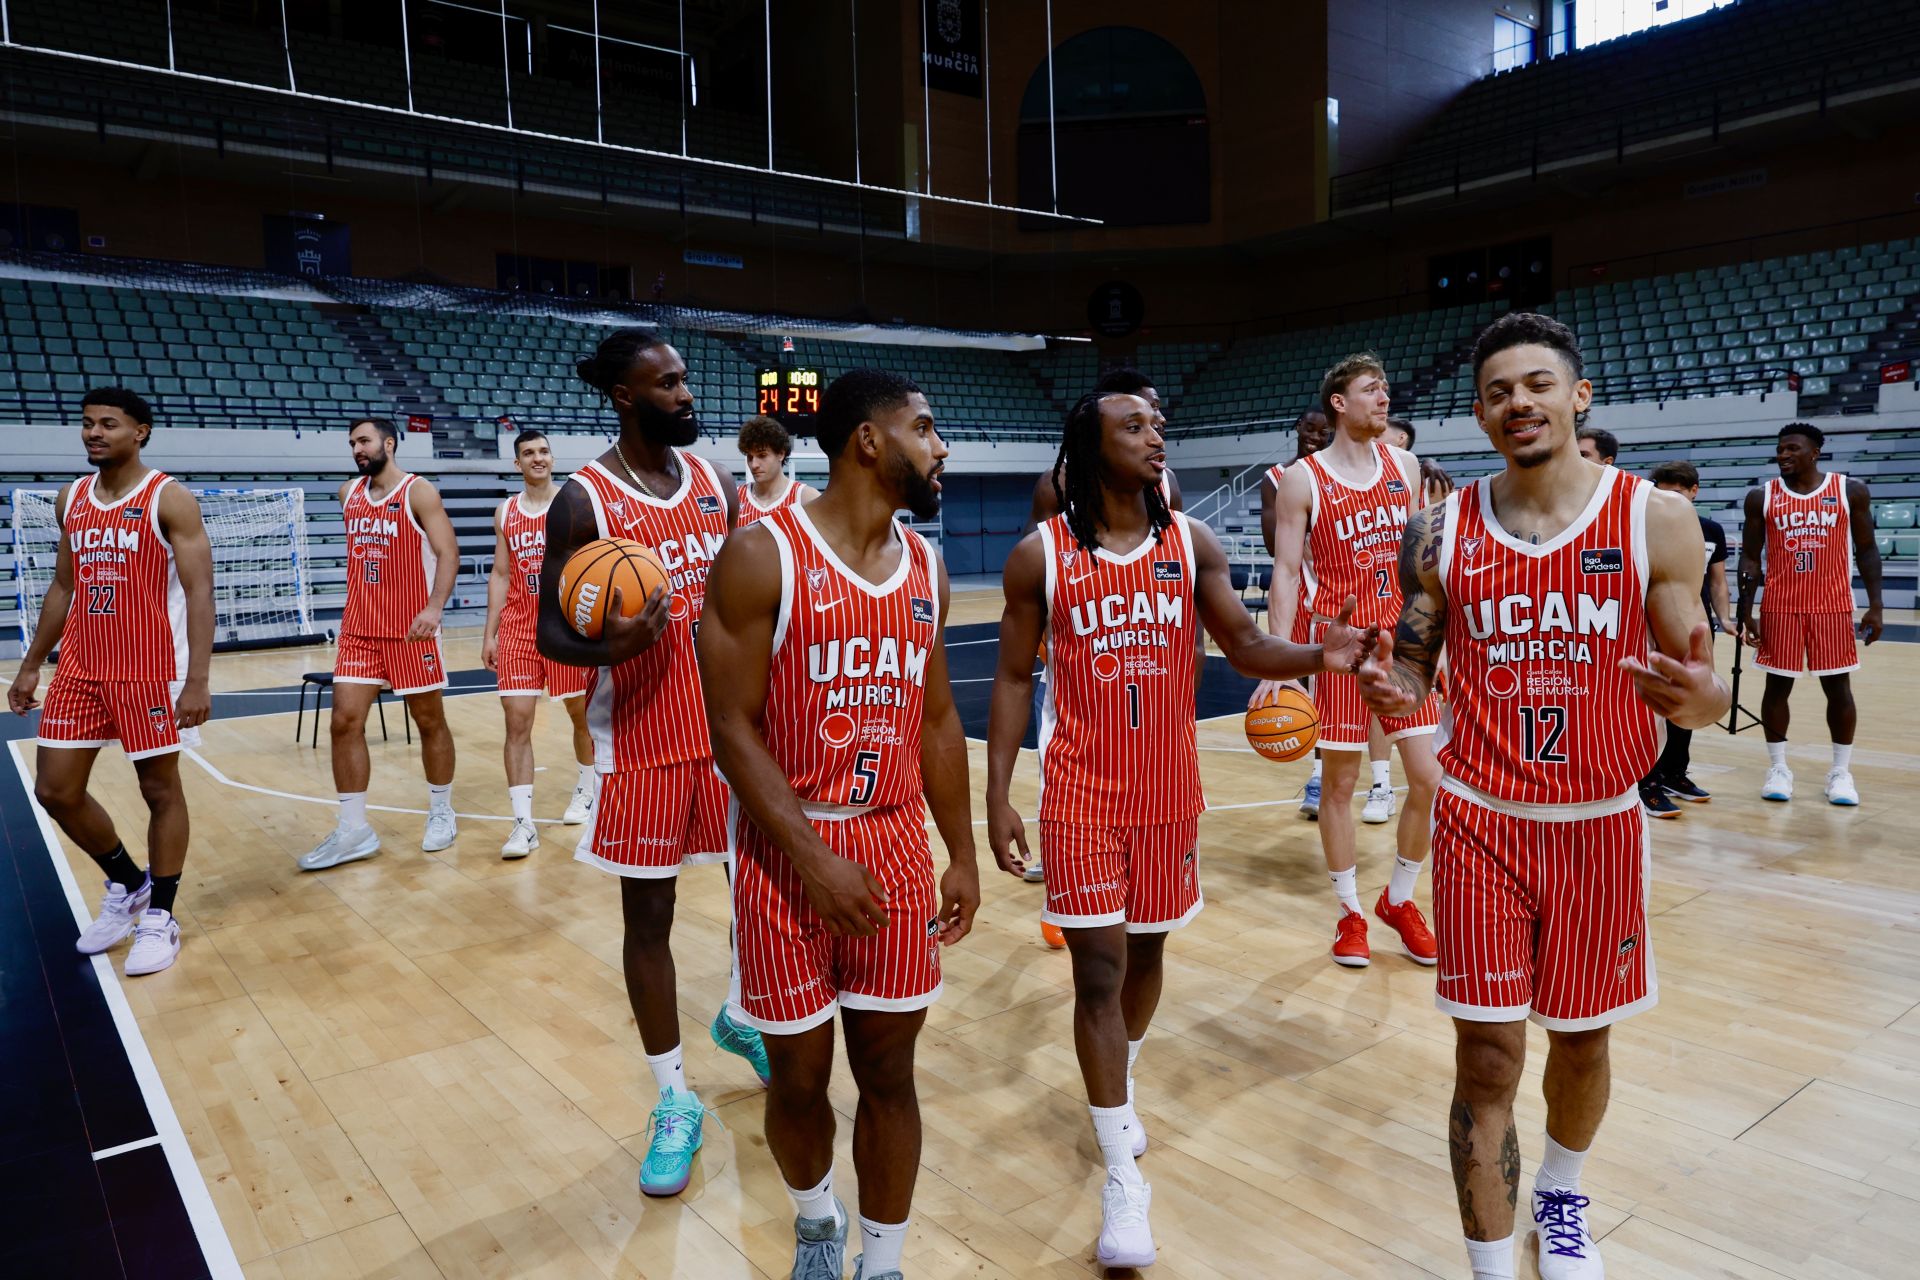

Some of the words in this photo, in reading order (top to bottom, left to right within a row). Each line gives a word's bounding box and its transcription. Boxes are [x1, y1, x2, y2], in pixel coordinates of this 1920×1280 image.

[760, 389, 778, 414] 24
[787, 387, 818, 413] 24
[348, 517, 398, 537] UCAM
[1336, 504, 1408, 541] UCAM
[1774, 510, 1838, 530] UCAM
[71, 527, 139, 553] UCAM
[355, 535, 389, 546] MURCIA
[1353, 530, 1403, 551] MURCIA
[1786, 527, 1828, 538] MURCIA
[79, 551, 126, 564] MURCIA
[649, 532, 725, 571] CAM
[1584, 557, 1601, 565] liga
[1795, 551, 1813, 572] 31
[365, 561, 380, 584] 15
[1585, 563, 1620, 571] endesa
[527, 573, 540, 595] 9
[1375, 569, 1393, 598] 2
[88, 585, 116, 615] 22
[1071, 591, 1184, 637] UCAM
[1463, 591, 1621, 641] UCAM
[1092, 629, 1168, 655] MURCIA
[1488, 639, 1594, 665] MURCIA
[808, 636, 928, 688] UCAM
[1137, 667, 1168, 677] MURCIA
[1526, 675, 1571, 686] REGIÓN
[1527, 687, 1543, 696] DE
[1545, 686, 1590, 696] MURCIA
[1126, 683, 1140, 730] 1
[1252, 736, 1301, 753] Wilson
[1518, 706, 1567, 763] 12
[847, 750, 881, 807] 5
